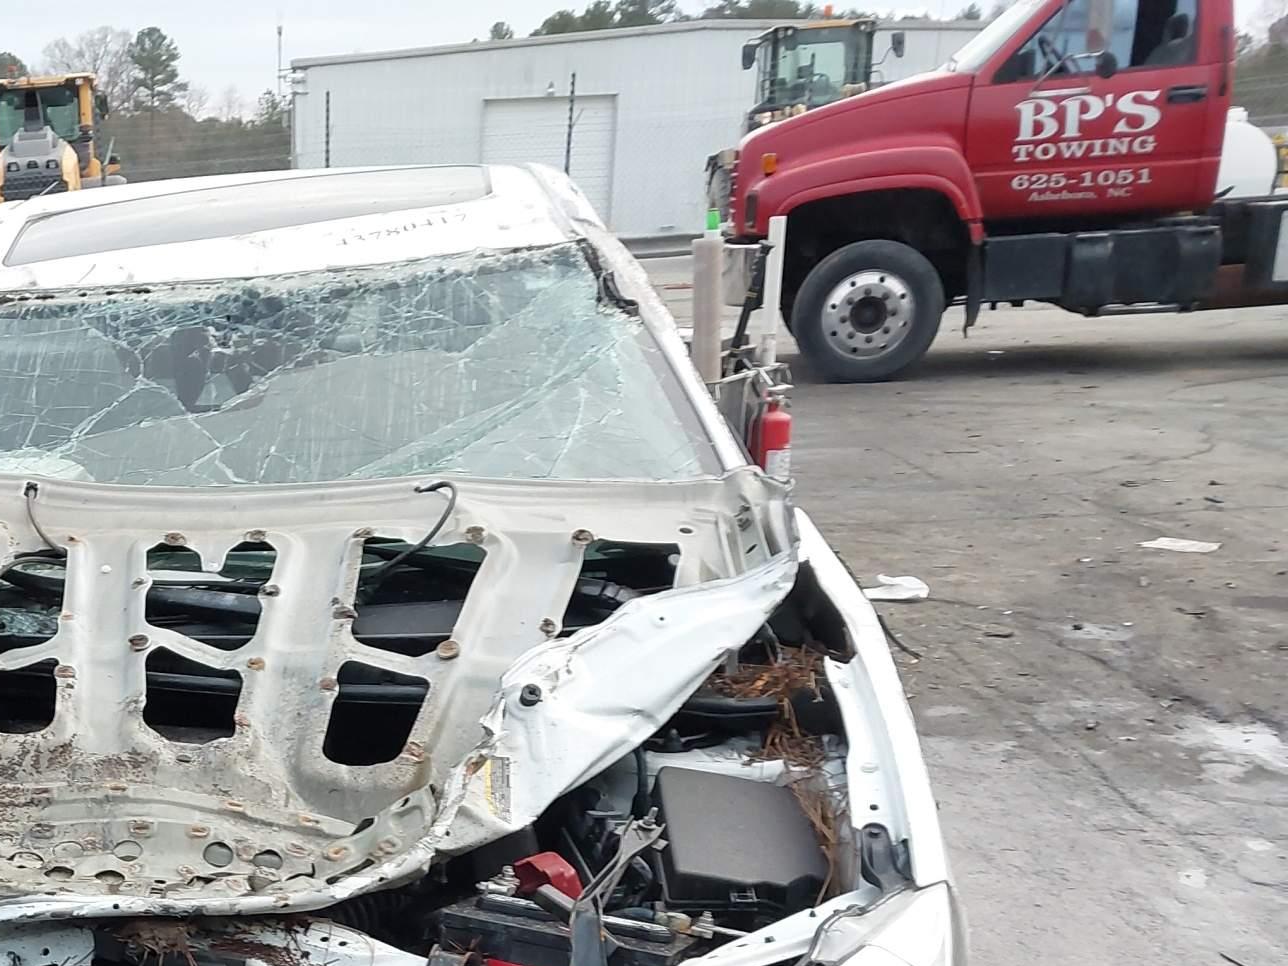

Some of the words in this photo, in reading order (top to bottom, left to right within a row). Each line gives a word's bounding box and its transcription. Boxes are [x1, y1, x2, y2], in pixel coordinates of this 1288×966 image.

[1014, 89, 1162, 141] BP'S
[1011, 135, 1158, 163] TOWING
[1010, 168, 1153, 190] 625-1051
